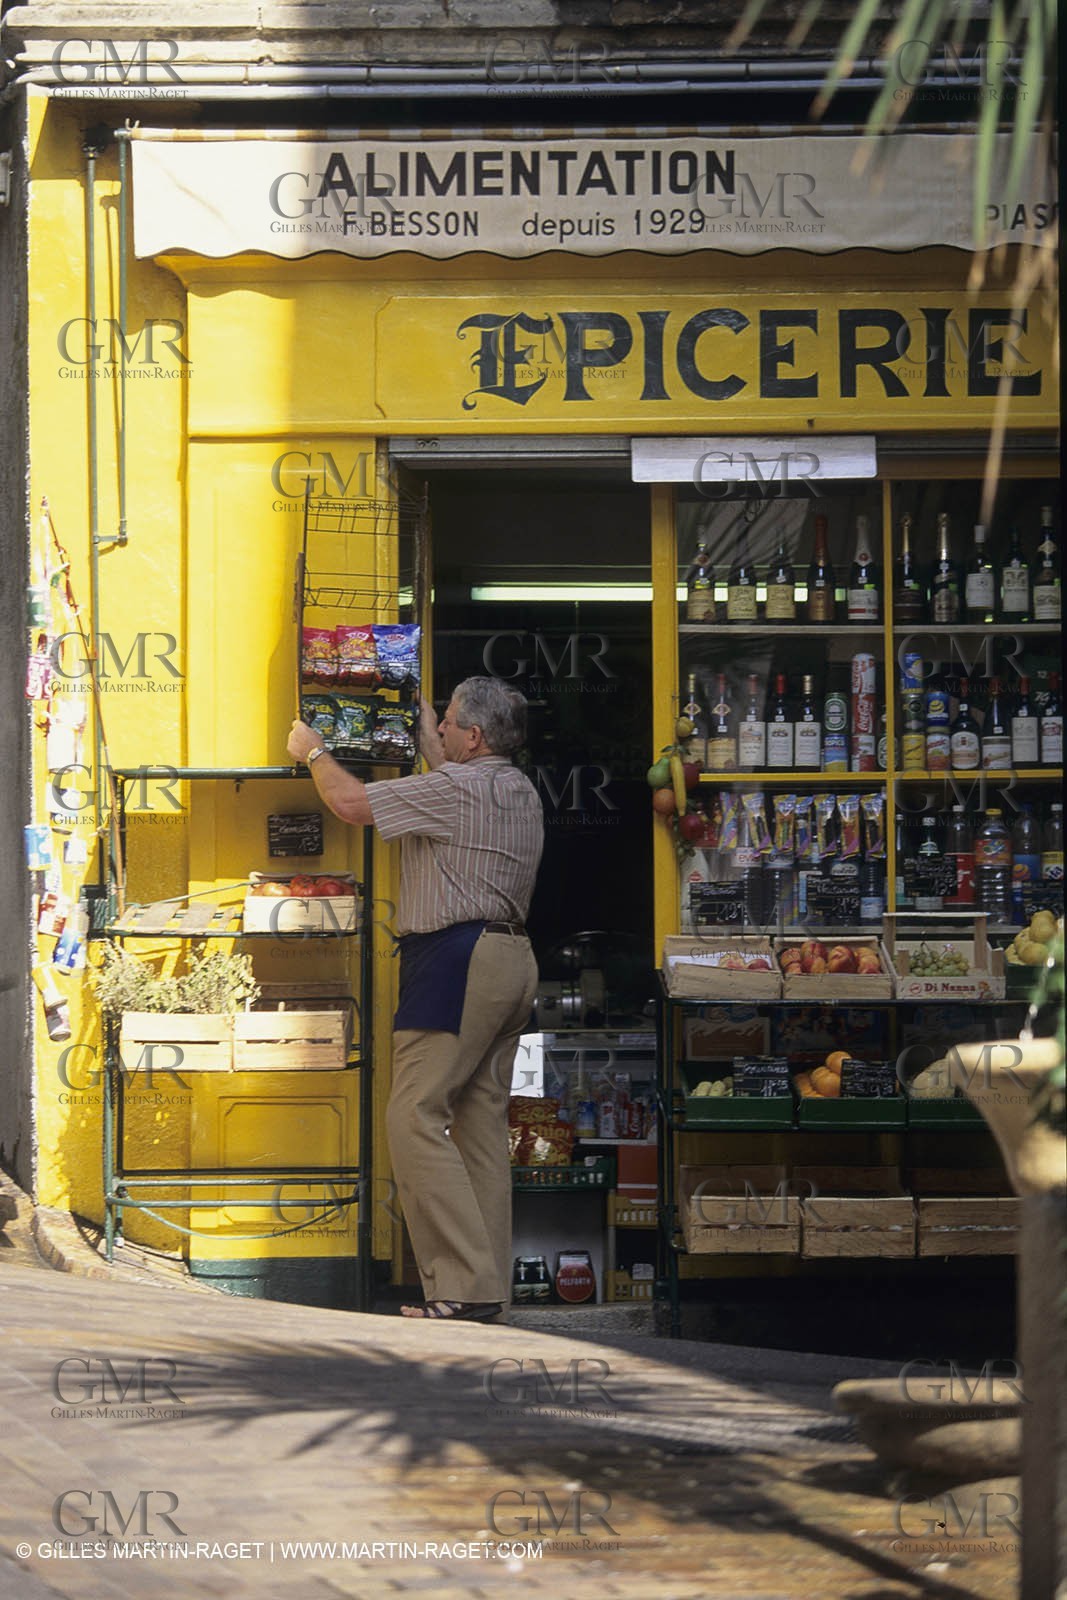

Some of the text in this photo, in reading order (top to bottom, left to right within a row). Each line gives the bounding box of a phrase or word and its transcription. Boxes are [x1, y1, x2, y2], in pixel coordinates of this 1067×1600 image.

[318, 150, 736, 197] ALIMENTATION
[522, 208, 615, 243] depuis
[634, 208, 706, 236] 1929
[456, 307, 1042, 411] EPICERIE
